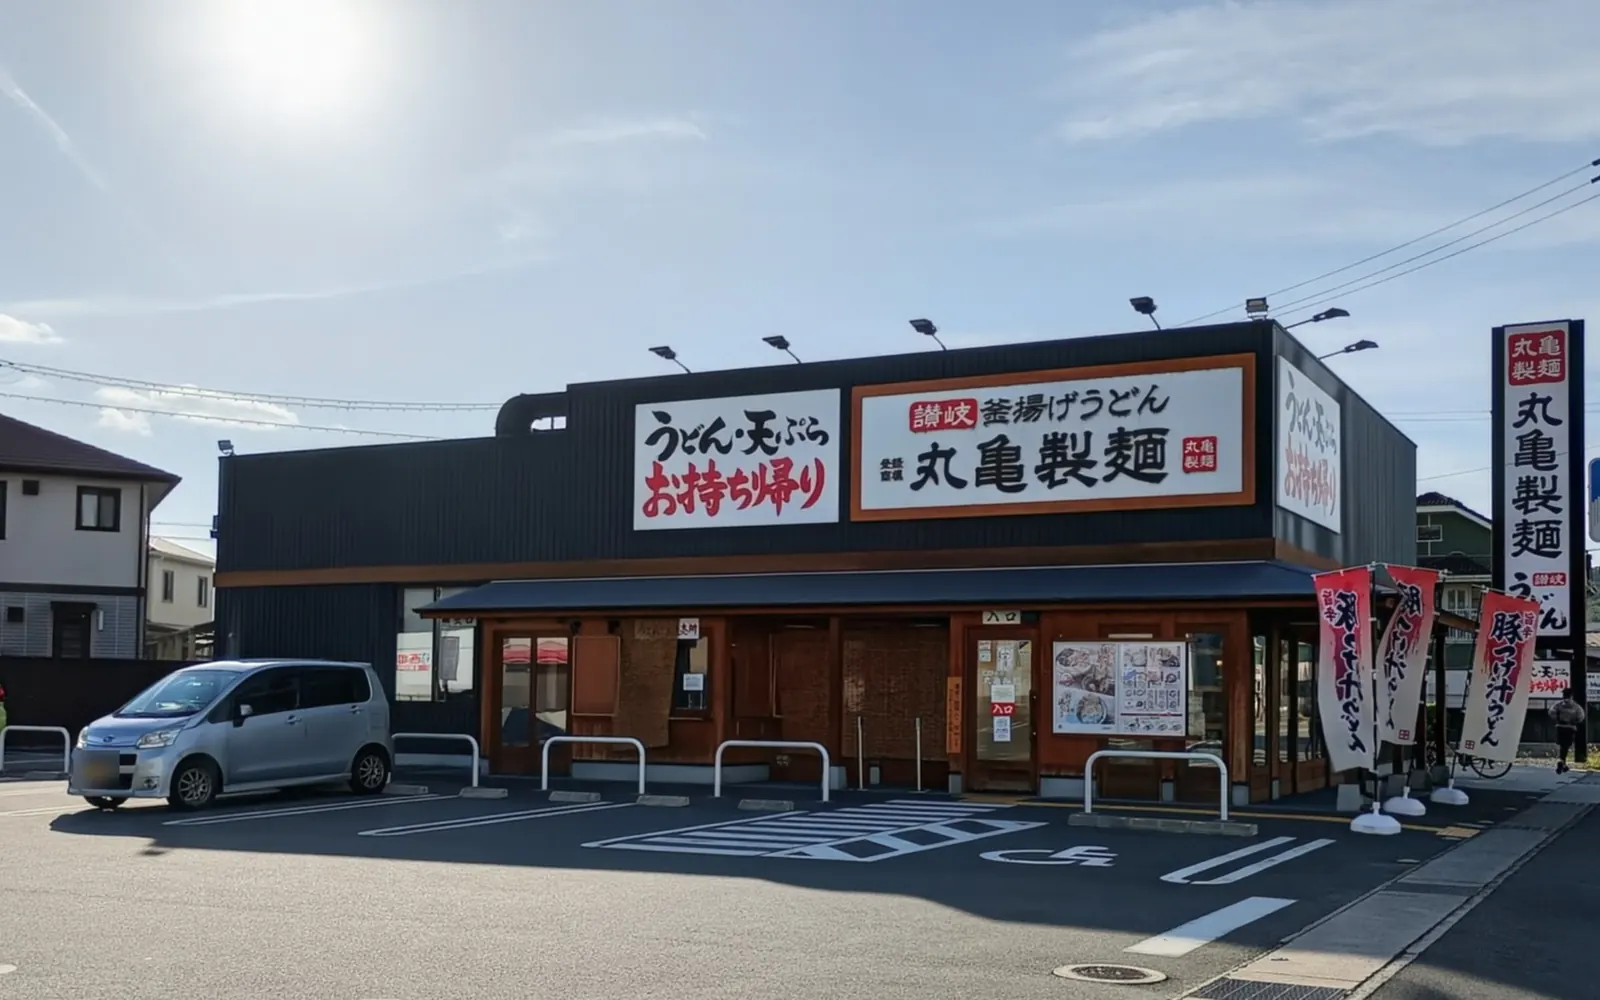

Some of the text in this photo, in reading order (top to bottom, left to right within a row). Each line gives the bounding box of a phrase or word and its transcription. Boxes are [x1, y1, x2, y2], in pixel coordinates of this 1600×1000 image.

[1511, 335, 1562, 358] 丸亀
[1511, 358, 1562, 381] 製麺
[912, 384, 1171, 429] 讃岐 釜揚げうどん
[644, 409, 829, 462] うどん・天ぷら
[910, 426, 1170, 494] 丸亀製麺
[642, 456, 825, 518] お持ち帰り
[1511, 392, 1563, 559] 丸亀製麺
[987, 611, 1017, 622] 入口
[1480, 611, 1524, 747] 豚つけ汁うどん
[992, 703, 1014, 714] 入口
